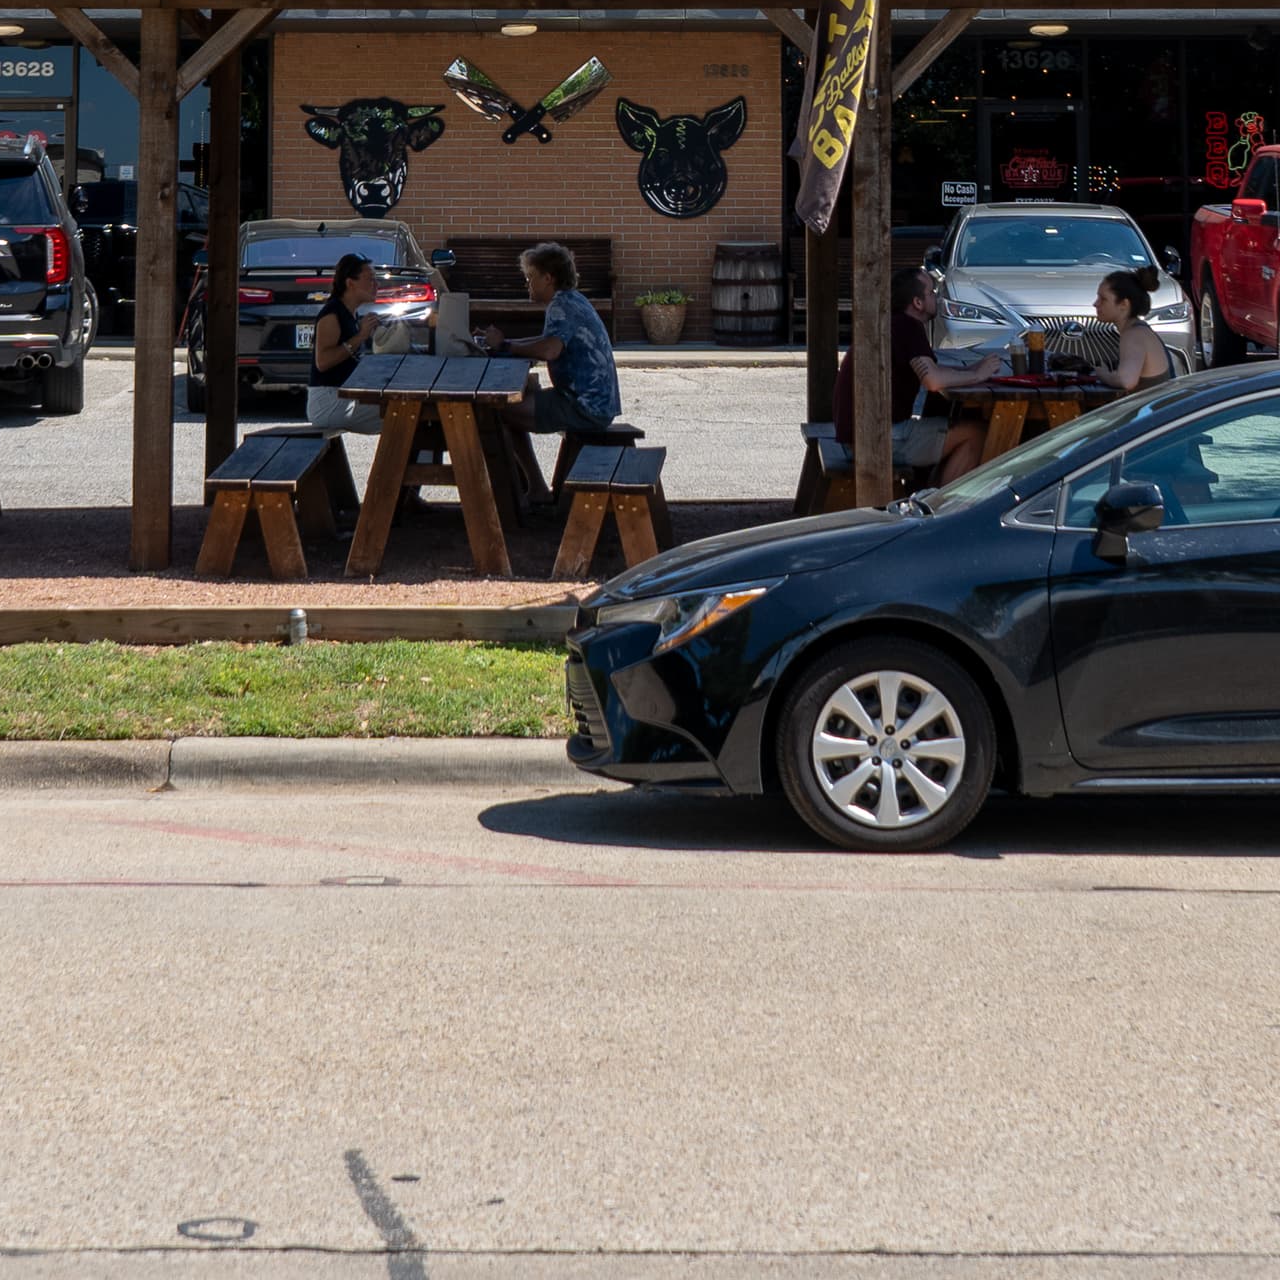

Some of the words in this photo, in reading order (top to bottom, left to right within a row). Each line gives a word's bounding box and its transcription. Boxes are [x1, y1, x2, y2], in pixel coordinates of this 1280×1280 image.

[999, 50, 1071, 70] 13626
[944, 184, 955, 194] No
[956, 184, 975, 194] Cash
